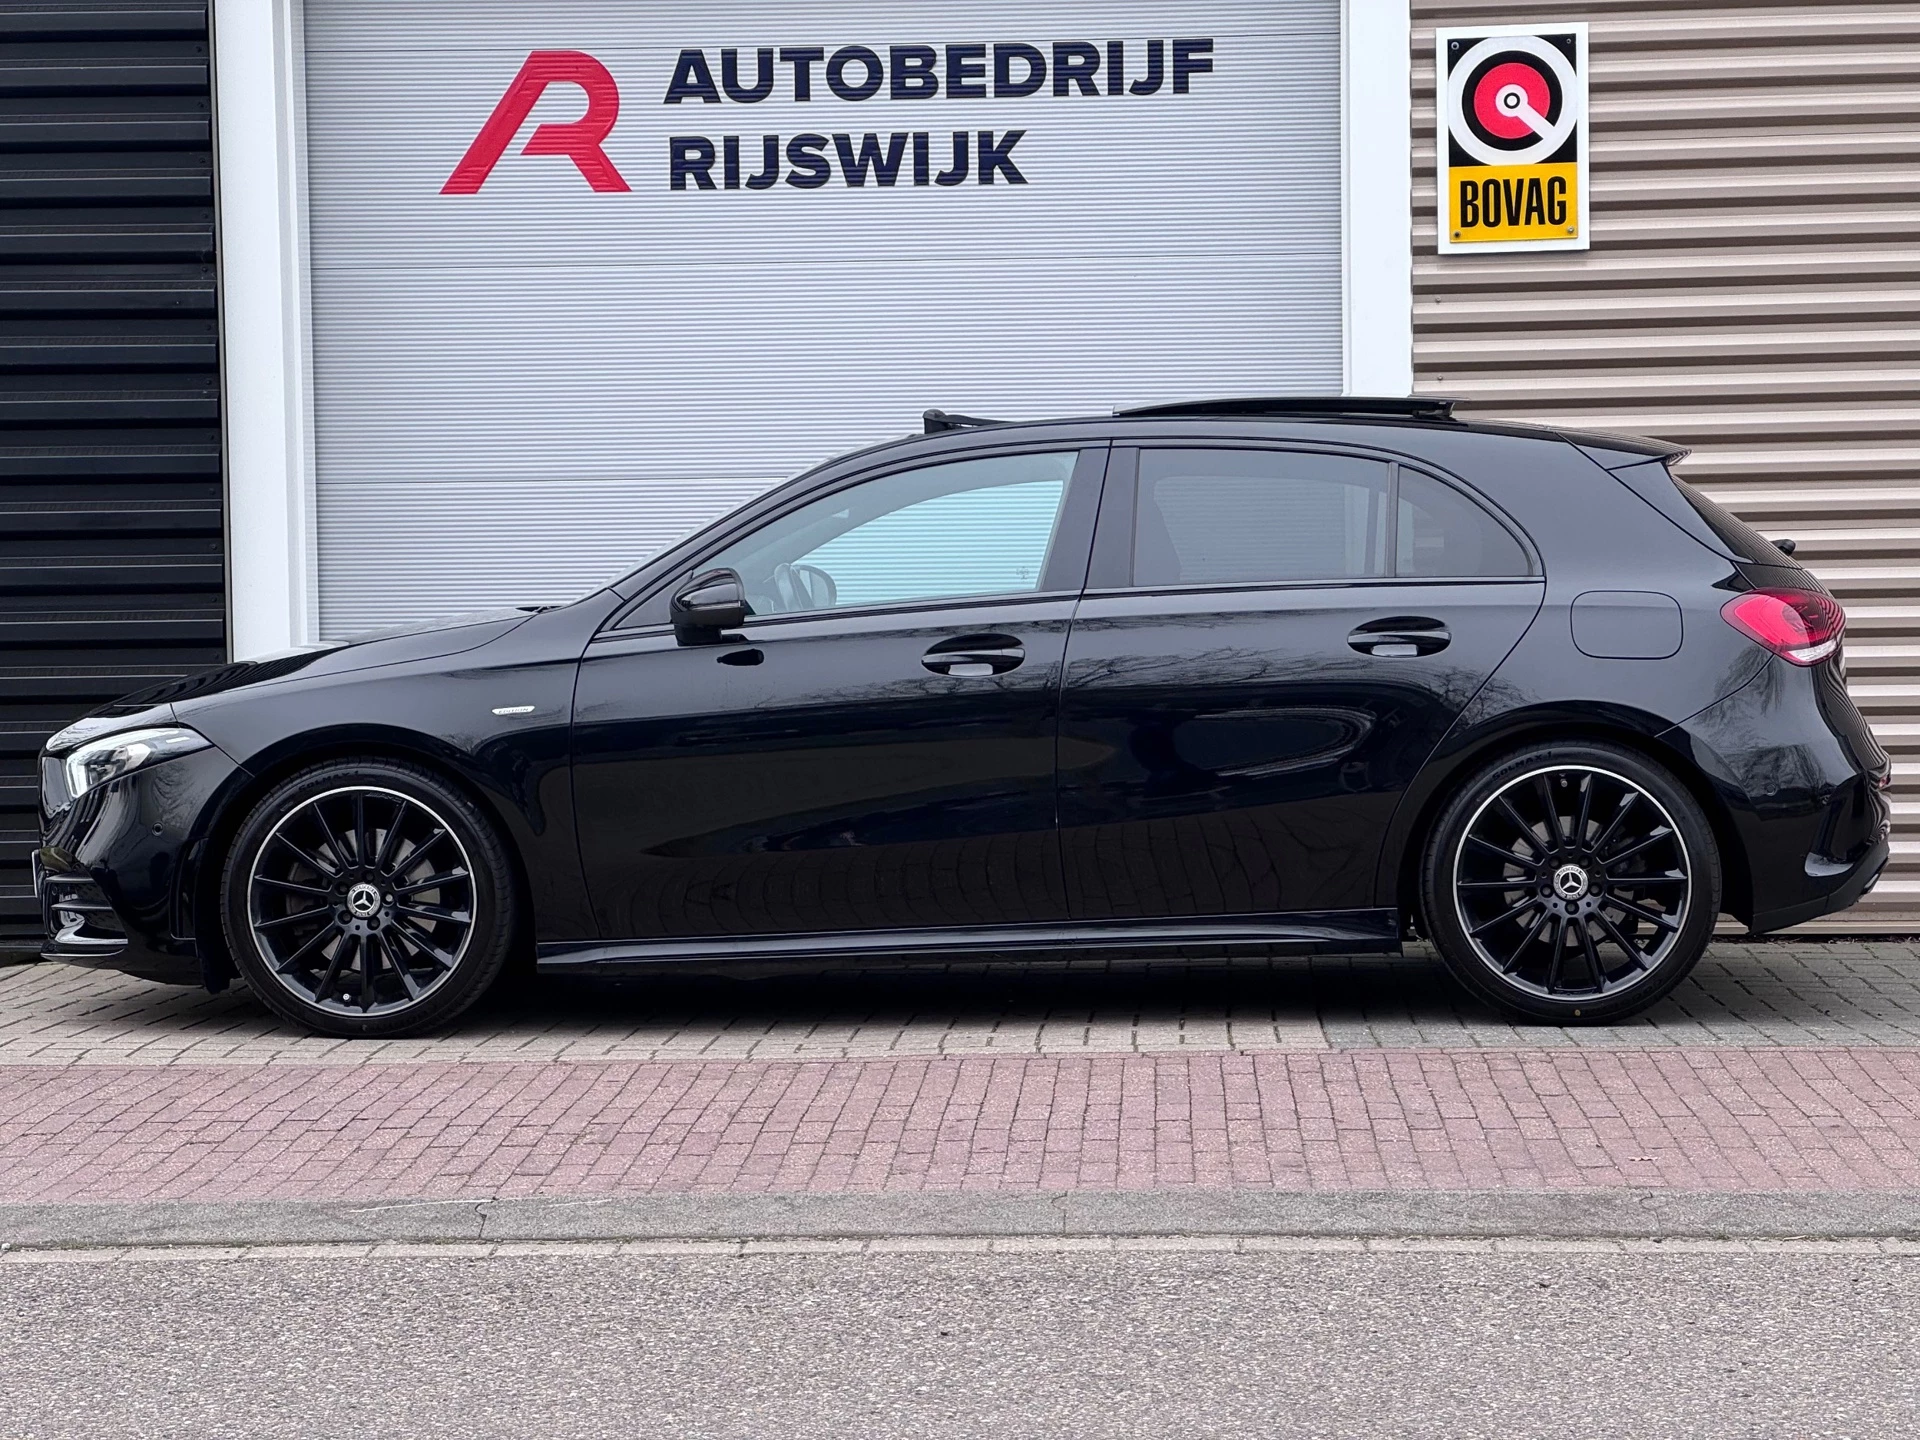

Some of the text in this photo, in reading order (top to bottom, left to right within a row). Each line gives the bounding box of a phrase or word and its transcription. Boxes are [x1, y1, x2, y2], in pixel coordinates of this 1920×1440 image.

[663, 38, 1214, 105] AUTOBEDRIJF
[669, 129, 1028, 191] RIJSWIJK
[1460, 176, 1567, 228] BOVAG
